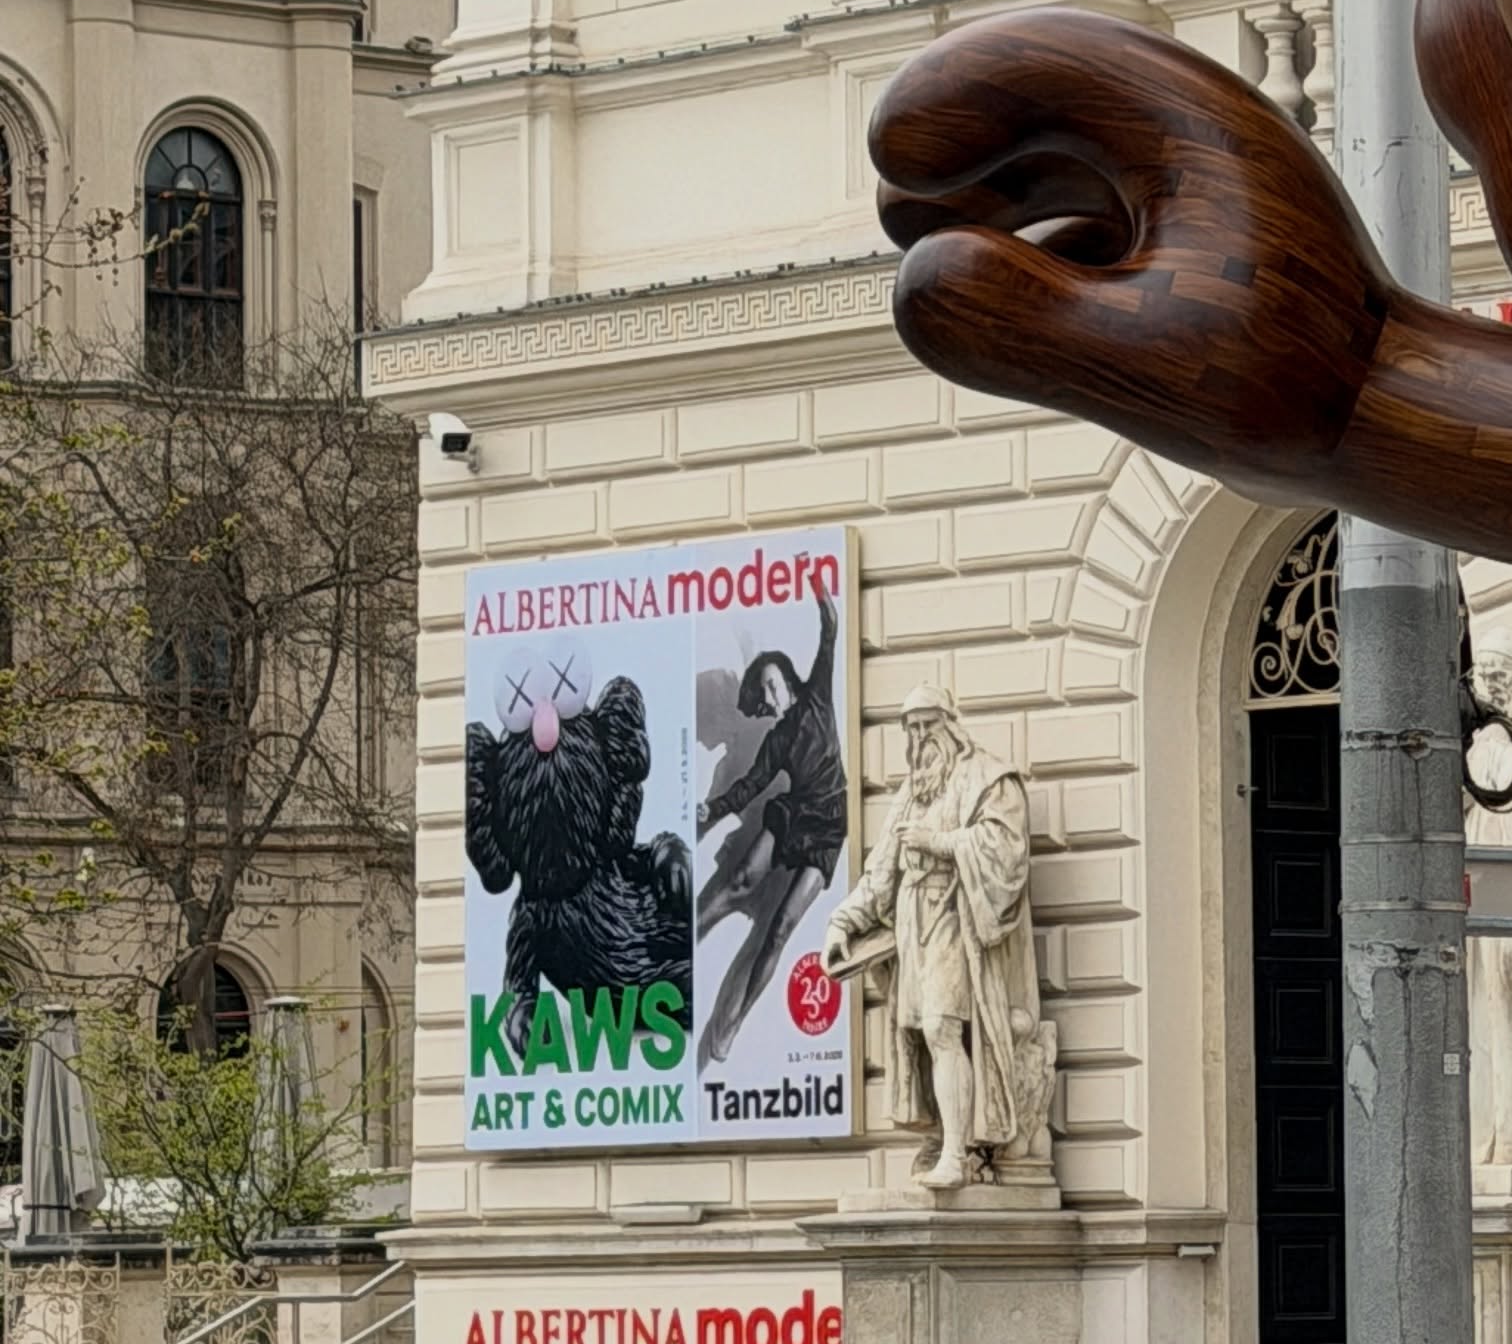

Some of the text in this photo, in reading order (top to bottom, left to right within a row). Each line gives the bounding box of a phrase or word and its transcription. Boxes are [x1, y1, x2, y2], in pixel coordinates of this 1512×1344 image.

[472, 548, 839, 636] ALBERTINA modern
[470, 980, 686, 1077] KAWS
[471, 1083, 685, 1130] ART & COMIX
[704, 1073, 843, 1121] Tanzbild
